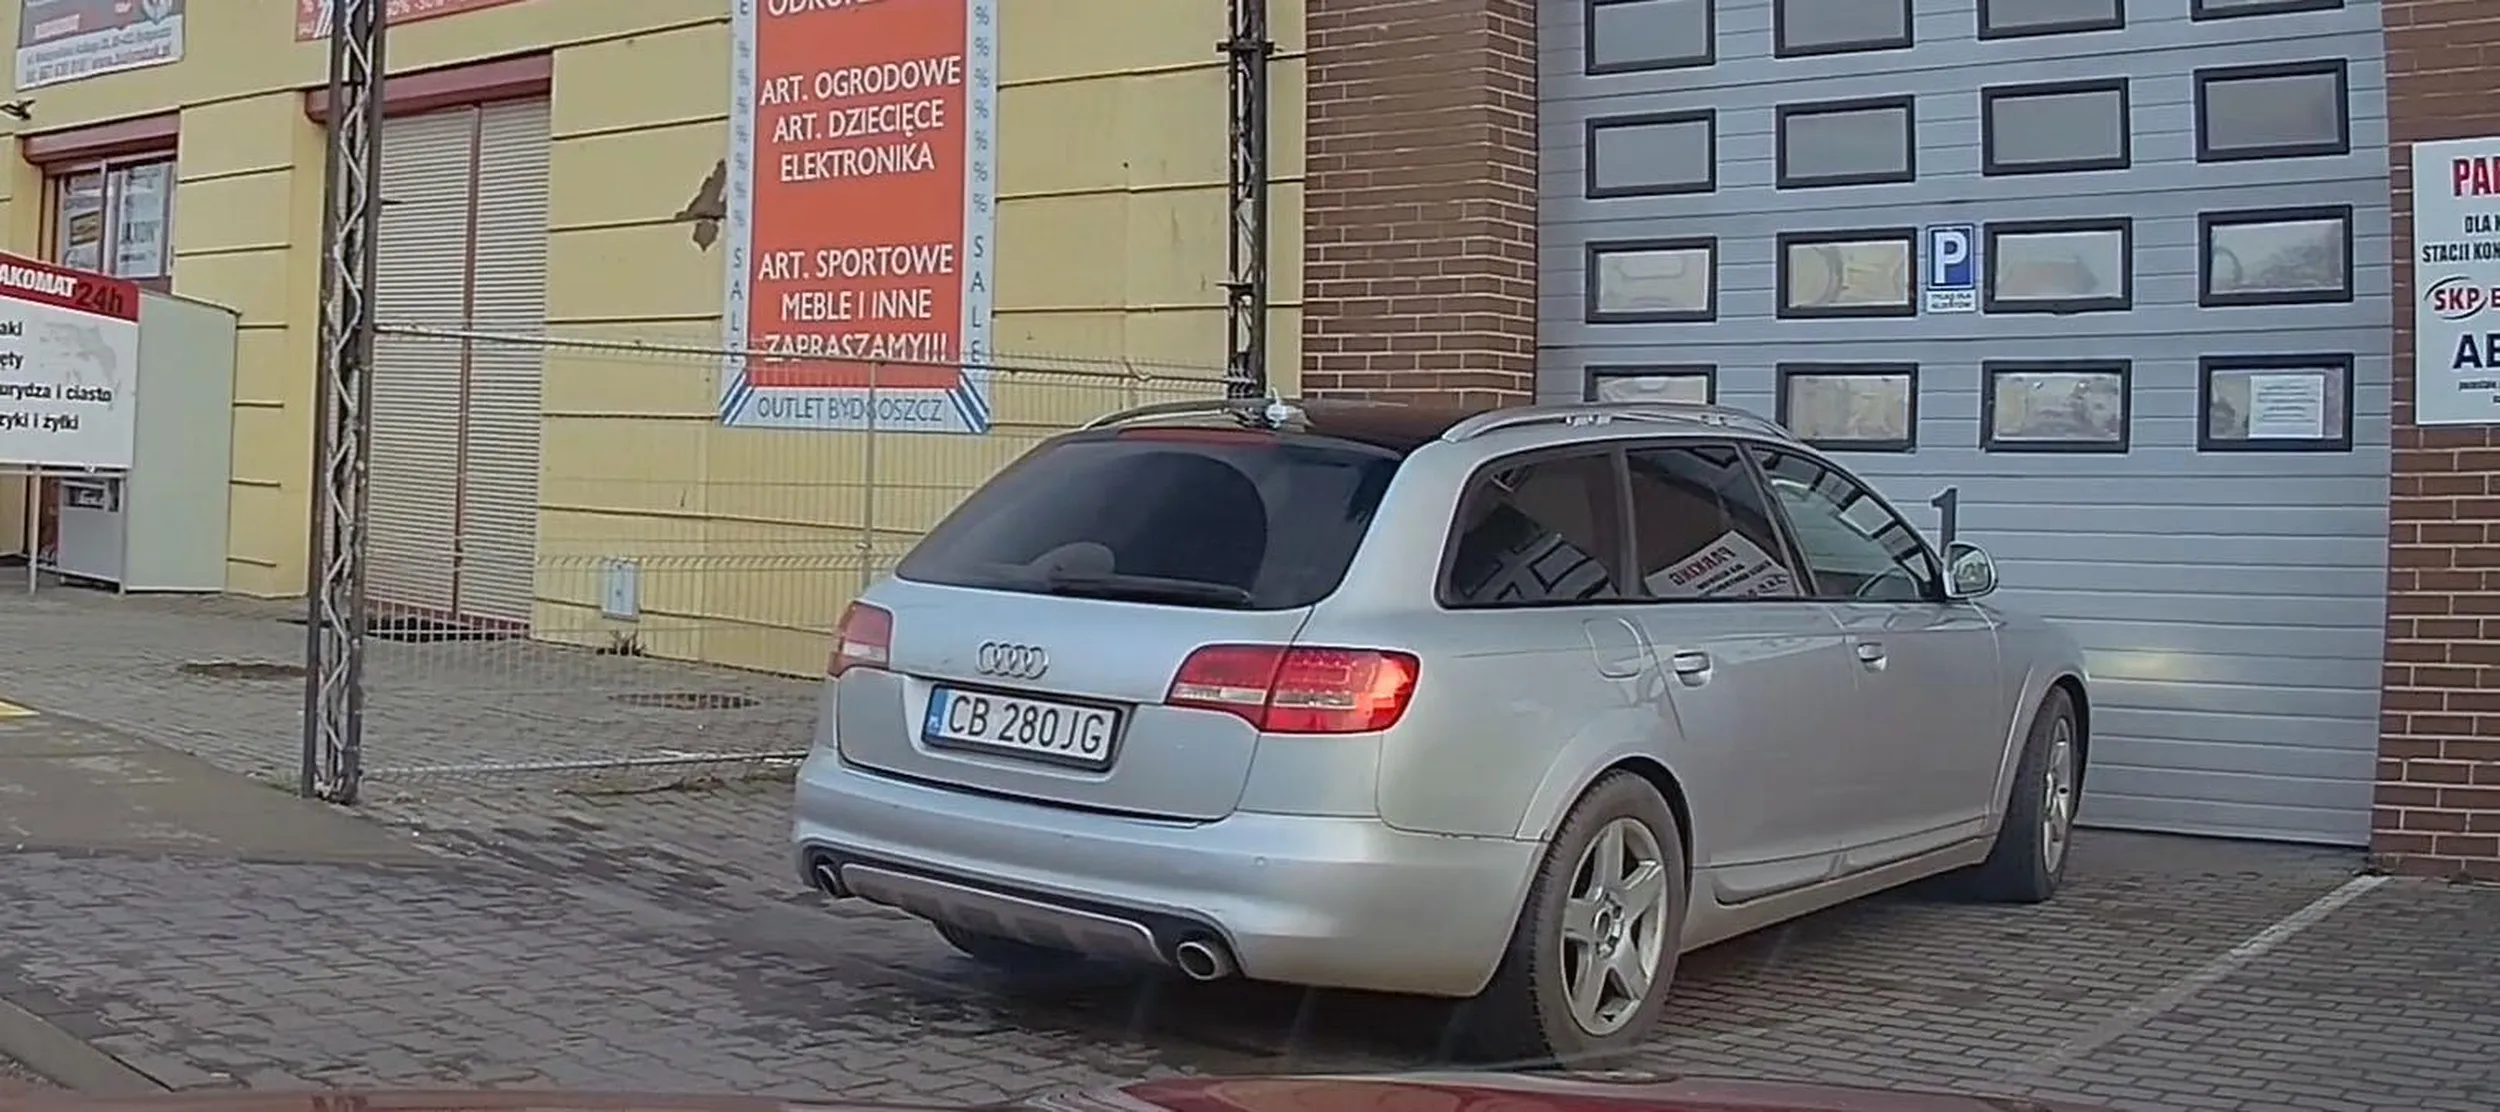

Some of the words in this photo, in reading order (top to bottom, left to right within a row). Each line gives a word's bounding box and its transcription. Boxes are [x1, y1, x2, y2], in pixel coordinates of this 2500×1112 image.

[760, 75, 808, 105] ART.
[815, 55, 961, 100] OGRODOWE
[772, 113, 821, 143] ART.
[829, 99, 944, 138] DZIECIĘCE
[780, 142, 935, 182] ELEKTRONIKA
[2465, 214, 2492, 233] DLA
[759, 250, 808, 280] ART.
[816, 244, 954, 277] SPORTOWE
[1934, 231, 1967, 284] P
[76, 282, 123, 313] 24h
[781, 291, 851, 321] MEBLE
[858, 291, 865, 320] I
[872, 289, 932, 320] INNE
[970, 236, 986, 363] SALE
[2434, 287, 2480, 311] SKP
[56, 383, 61, 399] i
[66, 384, 112, 402] ciasto
[757, 396, 824, 418] OUTLET
[34, 413, 38, 428] i
[949, 695, 990, 736] CB
[998, 703, 1105, 753] 280JG
